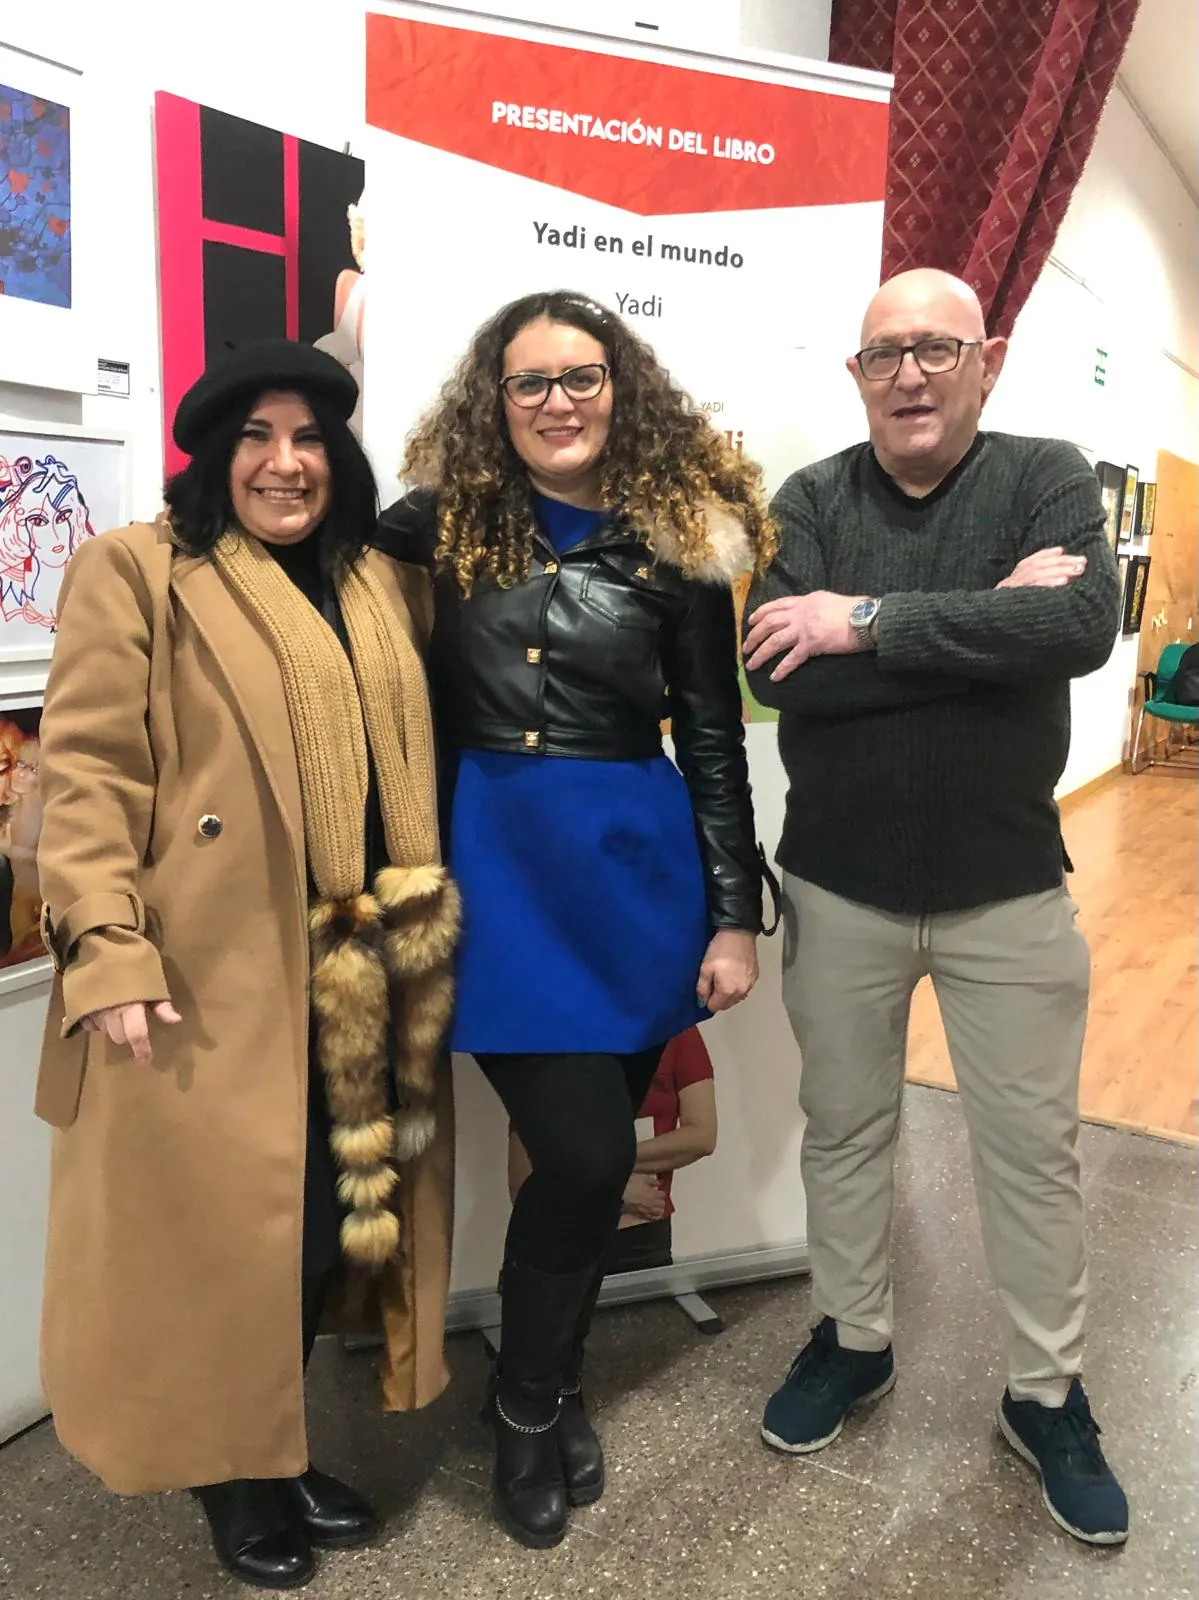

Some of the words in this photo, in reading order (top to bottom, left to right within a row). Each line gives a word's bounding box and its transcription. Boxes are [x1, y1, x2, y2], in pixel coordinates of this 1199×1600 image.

[491, 100, 663, 148] PRESENTACIÓN
[668, 128, 708, 156] DEL
[713, 135, 775, 165] LIBRO
[533, 221, 586, 249] Yadi
[594, 235, 623, 254] en
[631, 234, 653, 257] el
[661, 245, 744, 269] mundo
[615, 292, 662, 318] Yadi
[700, 401, 724, 413] YADI
